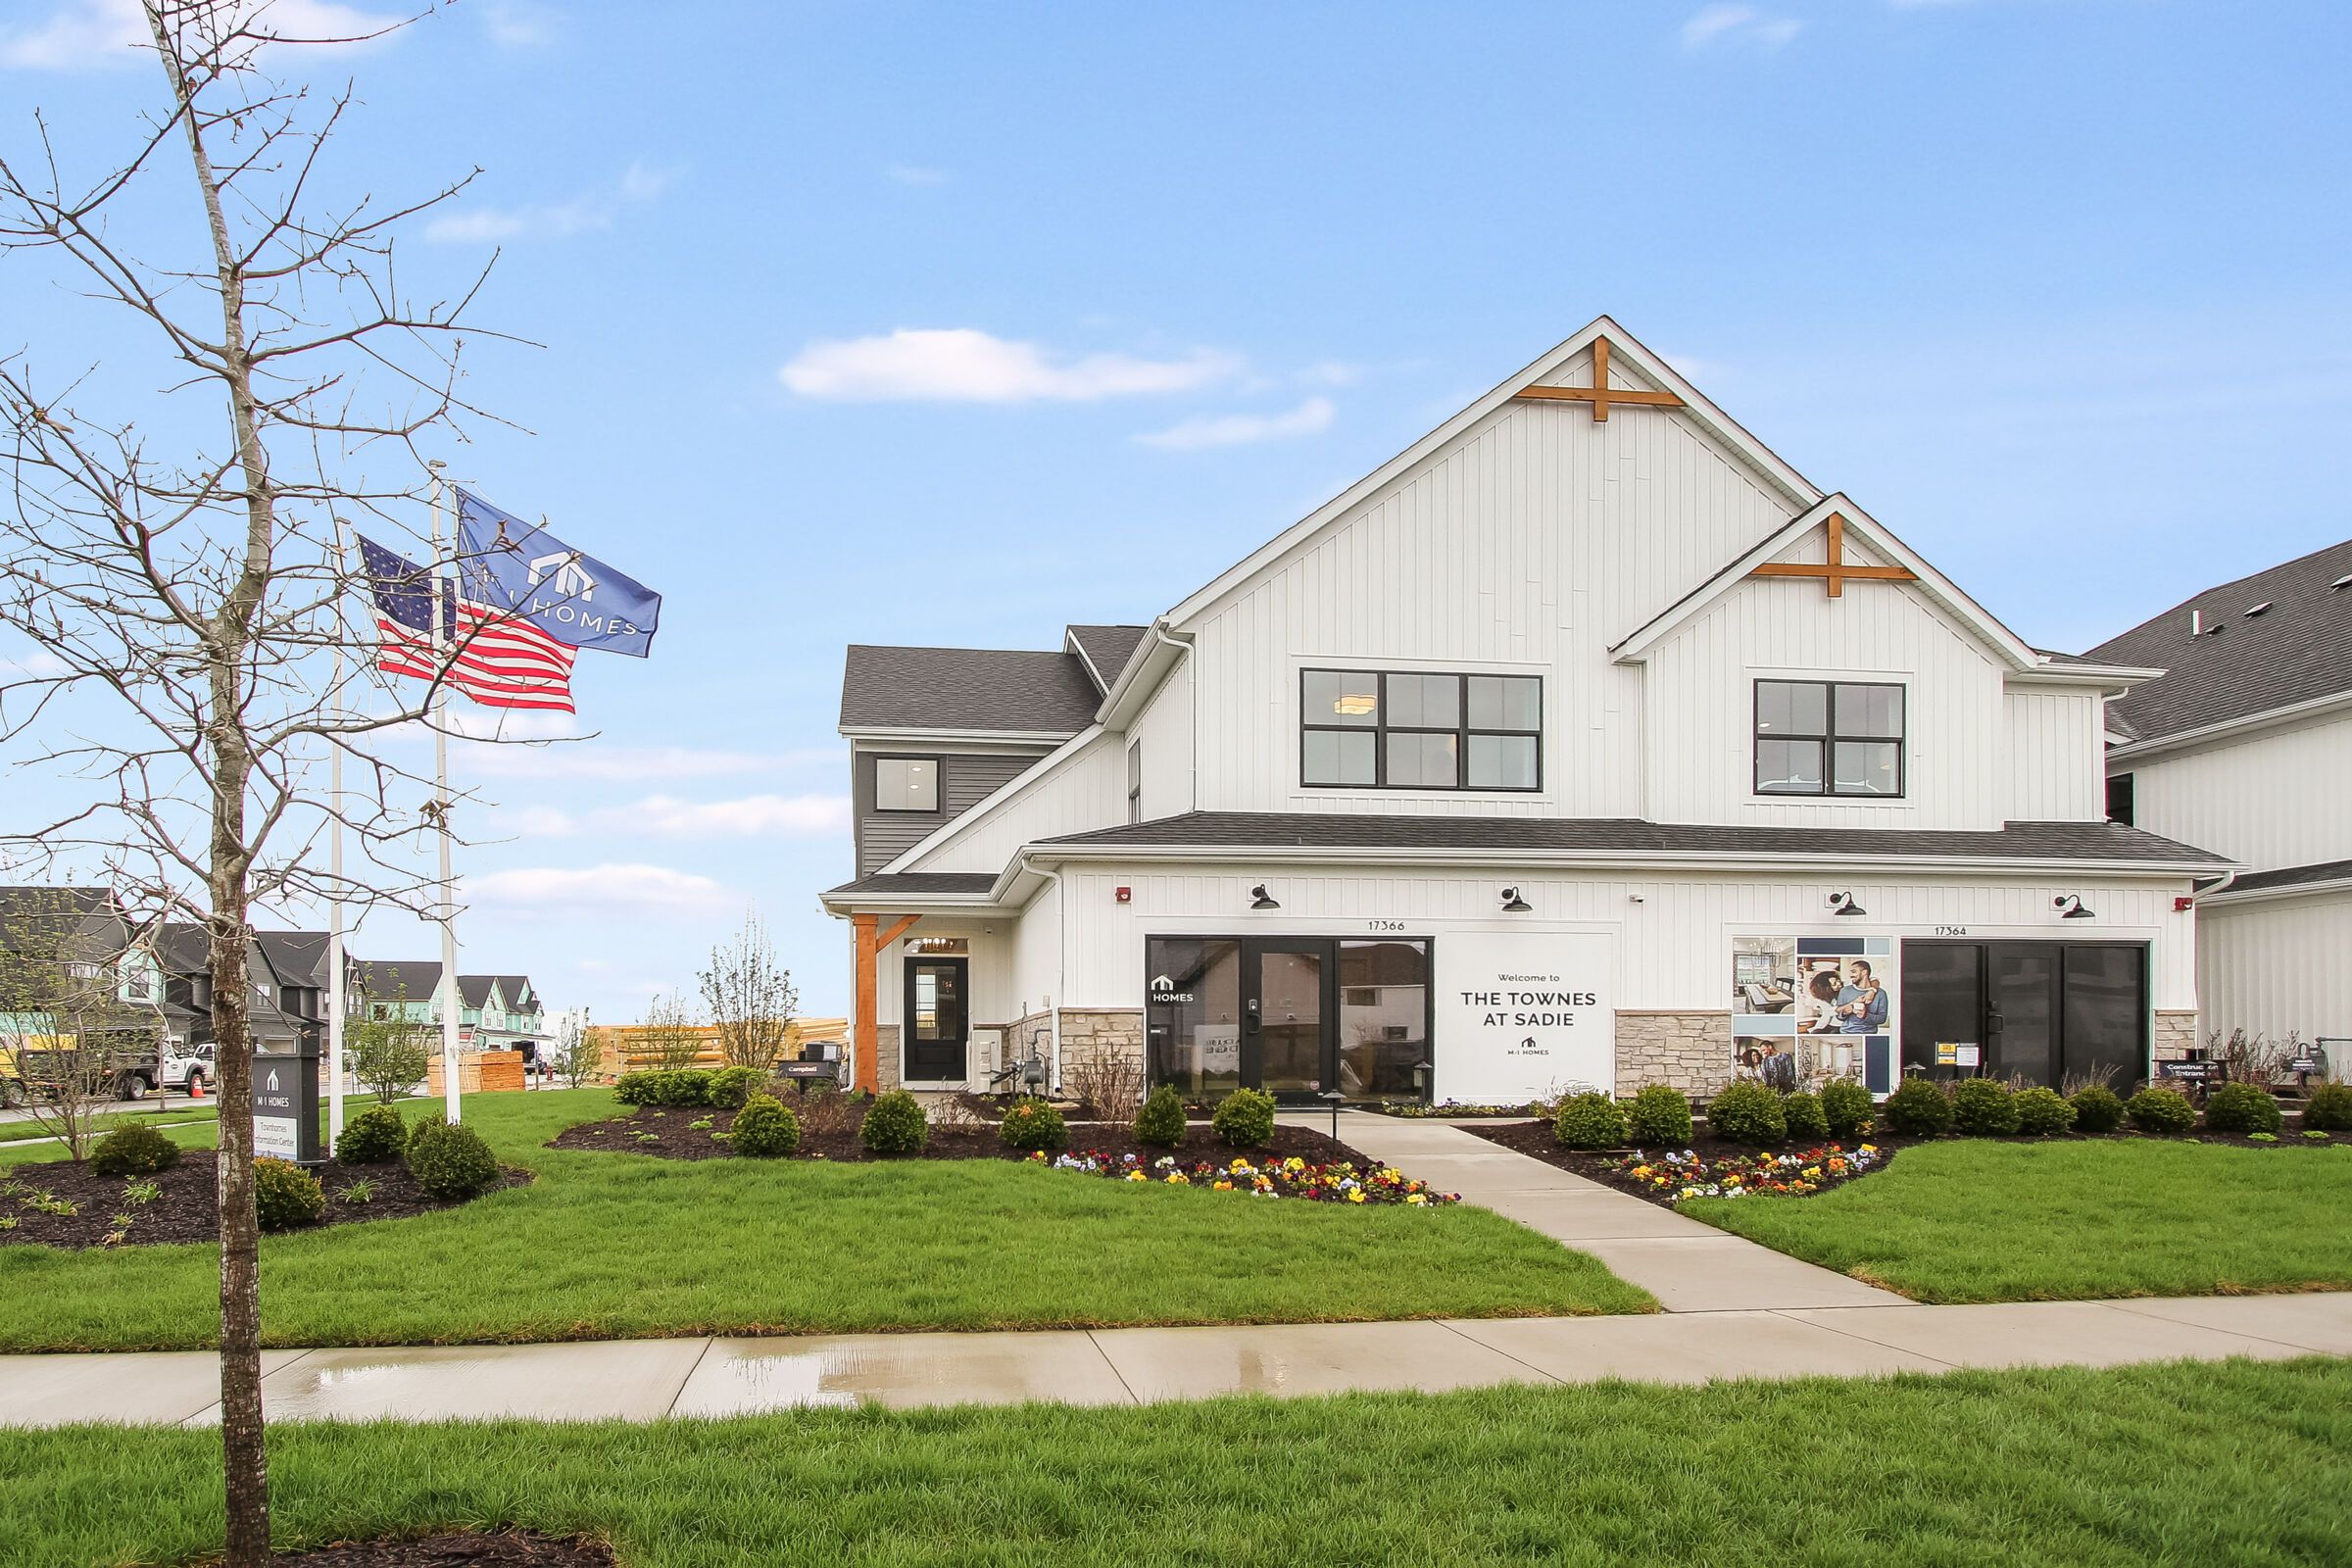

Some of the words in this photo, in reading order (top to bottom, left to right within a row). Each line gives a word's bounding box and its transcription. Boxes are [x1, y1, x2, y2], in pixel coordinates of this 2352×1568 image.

[530, 597, 639, 636] HOMES
[1368, 920, 1405, 931] 17366
[1935, 926, 1967, 936] 17364
[1497, 973, 1546, 982] Welcome
[1152, 993, 1194, 1002] HOMES
[1460, 992, 1501, 1005] THE
[1507, 992, 1596, 1005] TOWNES
[1483, 1012, 1508, 1026] AT
[1514, 1012, 1574, 1026] SADIE
[268, 1097, 290, 1107] HOMES
[260, 1121, 287, 1133] Townhomes
[255, 1135, 278, 1146] nformation
[278, 1136, 295, 1147] Center
